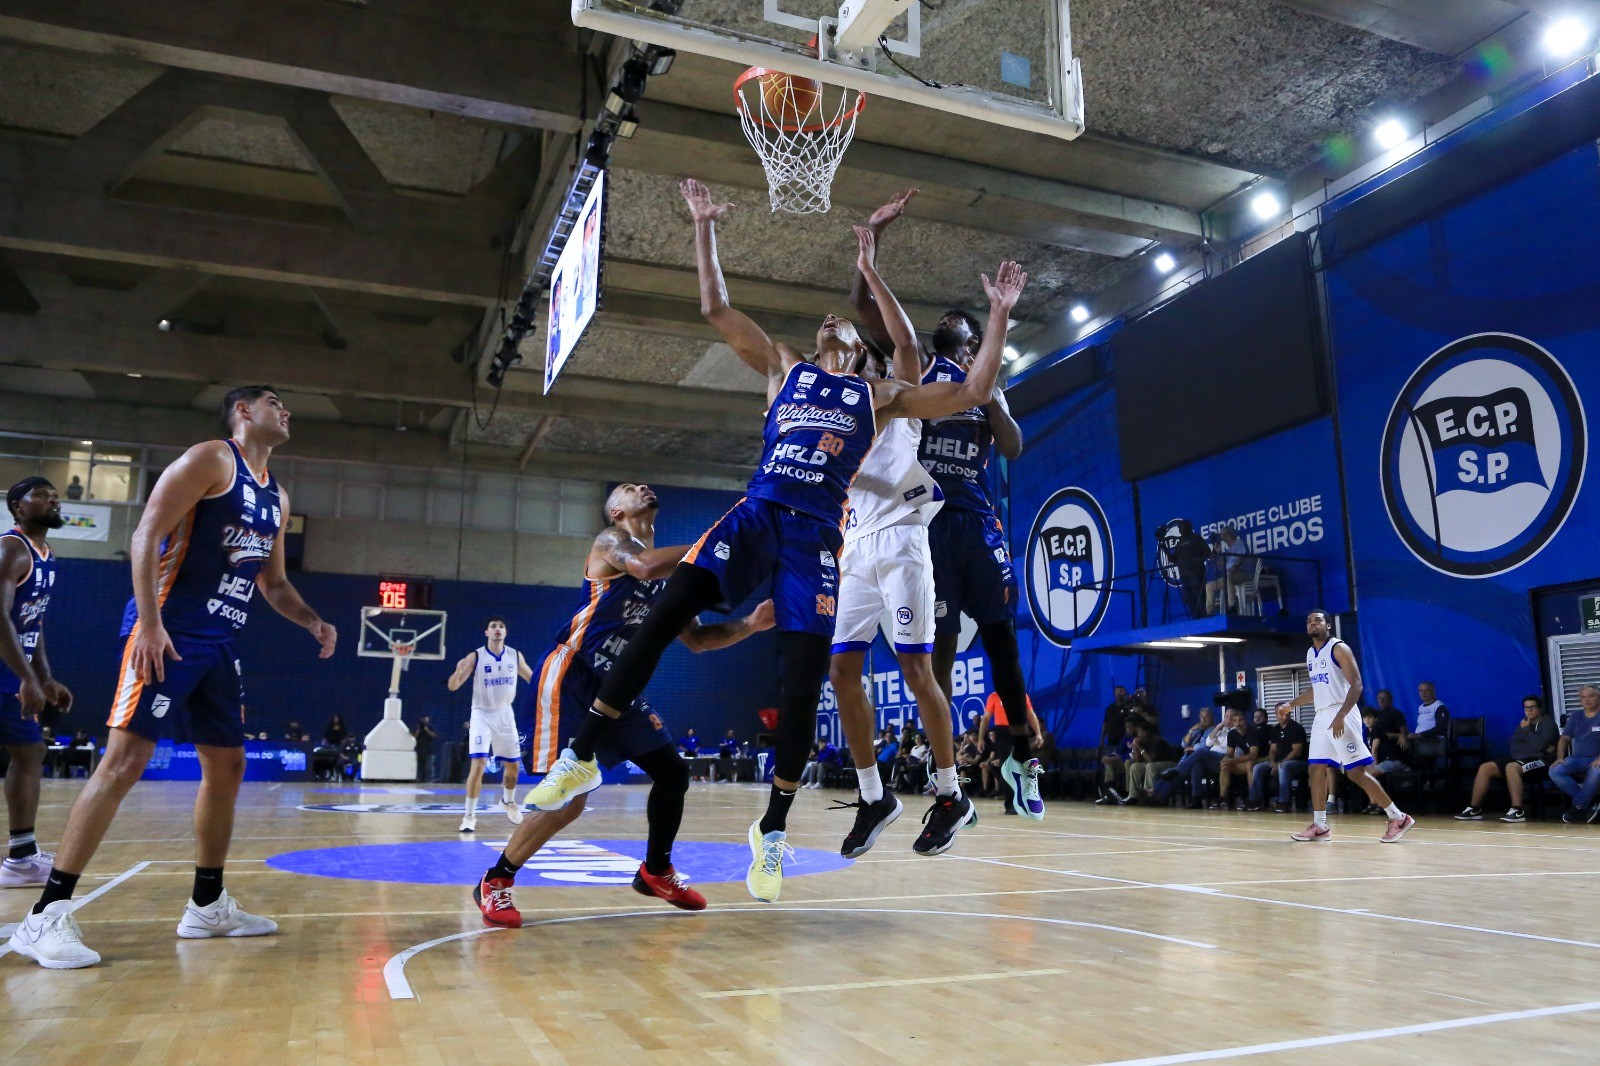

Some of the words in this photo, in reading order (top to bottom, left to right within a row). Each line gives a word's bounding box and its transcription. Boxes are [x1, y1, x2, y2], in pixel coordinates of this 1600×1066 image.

[1435, 401, 1518, 442] E.C.P.
[925, 435, 980, 461] HELP
[773, 463, 825, 484] SICOOB
[936, 462, 979, 479] SICOOB
[1457, 449, 1510, 484] S.P.
[1267, 494, 1323, 523] CLUBE
[1050, 533, 1087, 557] E.C.P.
[1059, 563, 1082, 588] S.P.
[382, 591, 406, 608] 06
